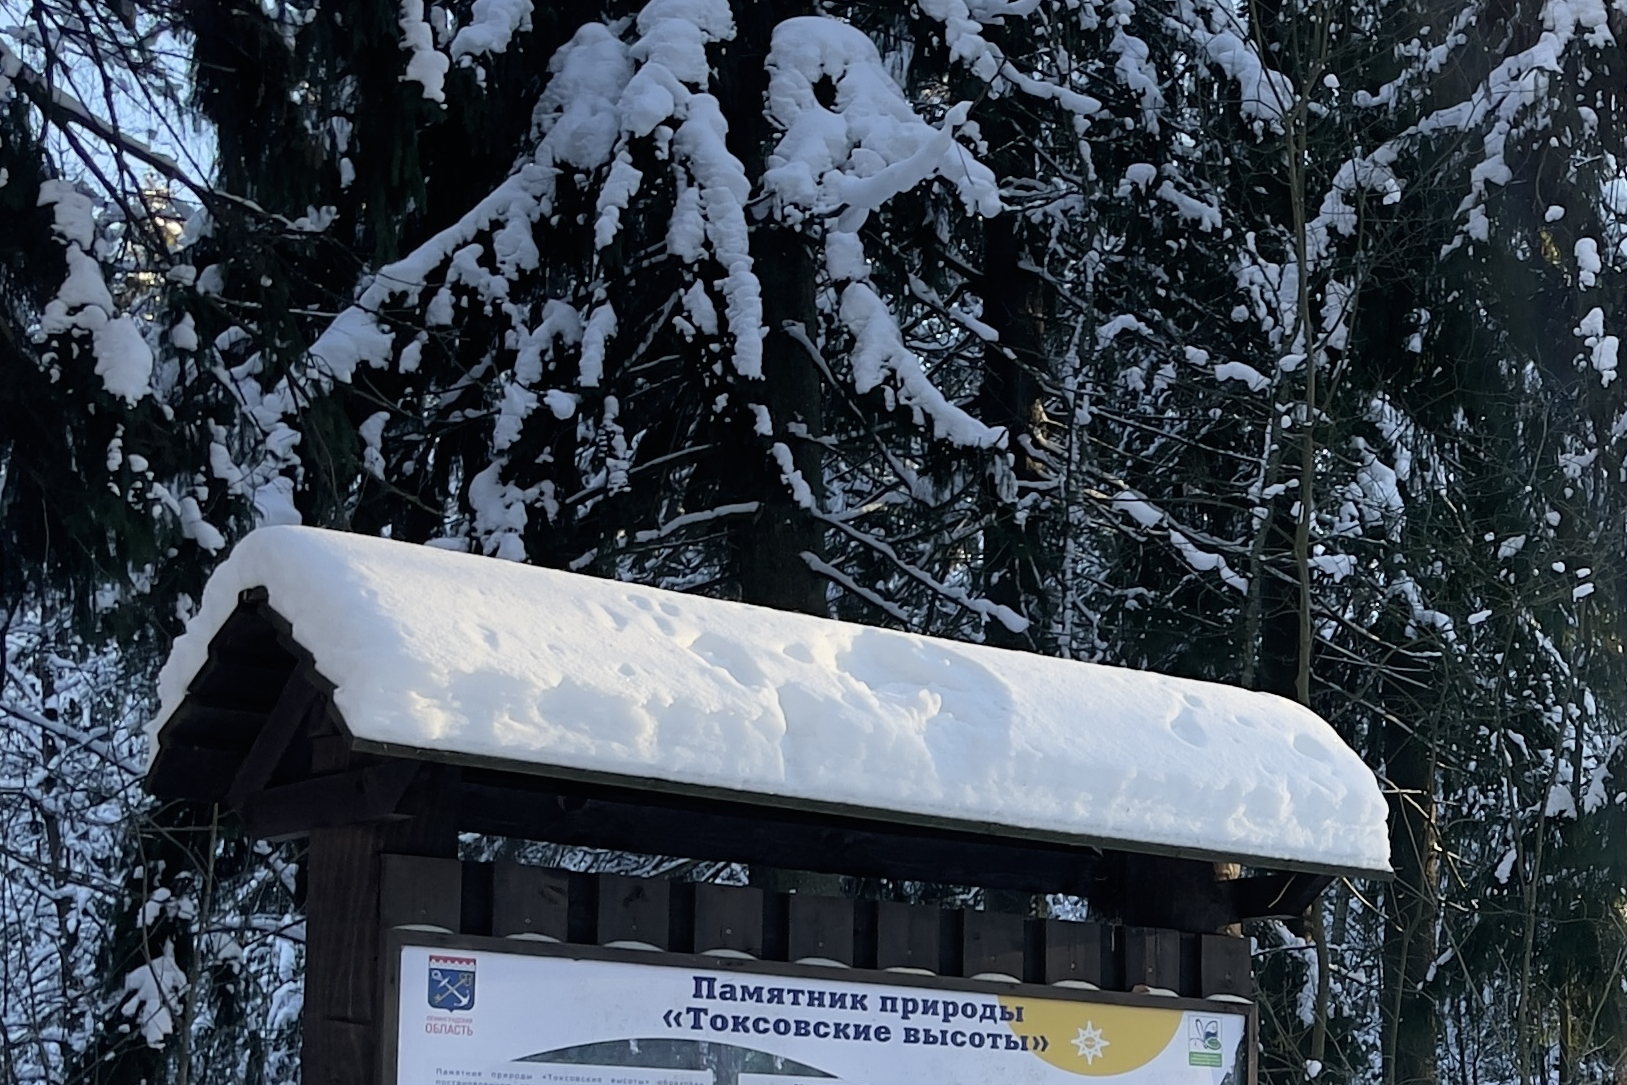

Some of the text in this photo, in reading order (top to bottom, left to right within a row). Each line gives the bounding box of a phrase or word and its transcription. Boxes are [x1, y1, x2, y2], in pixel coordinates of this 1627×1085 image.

[692, 975, 1025, 1024] Памятник природы
[425, 1022, 474, 1037] ОБЛАСТЬ
[663, 1006, 1050, 1053] «Токсовские высоты»
[490, 1071, 533, 1081] природы
